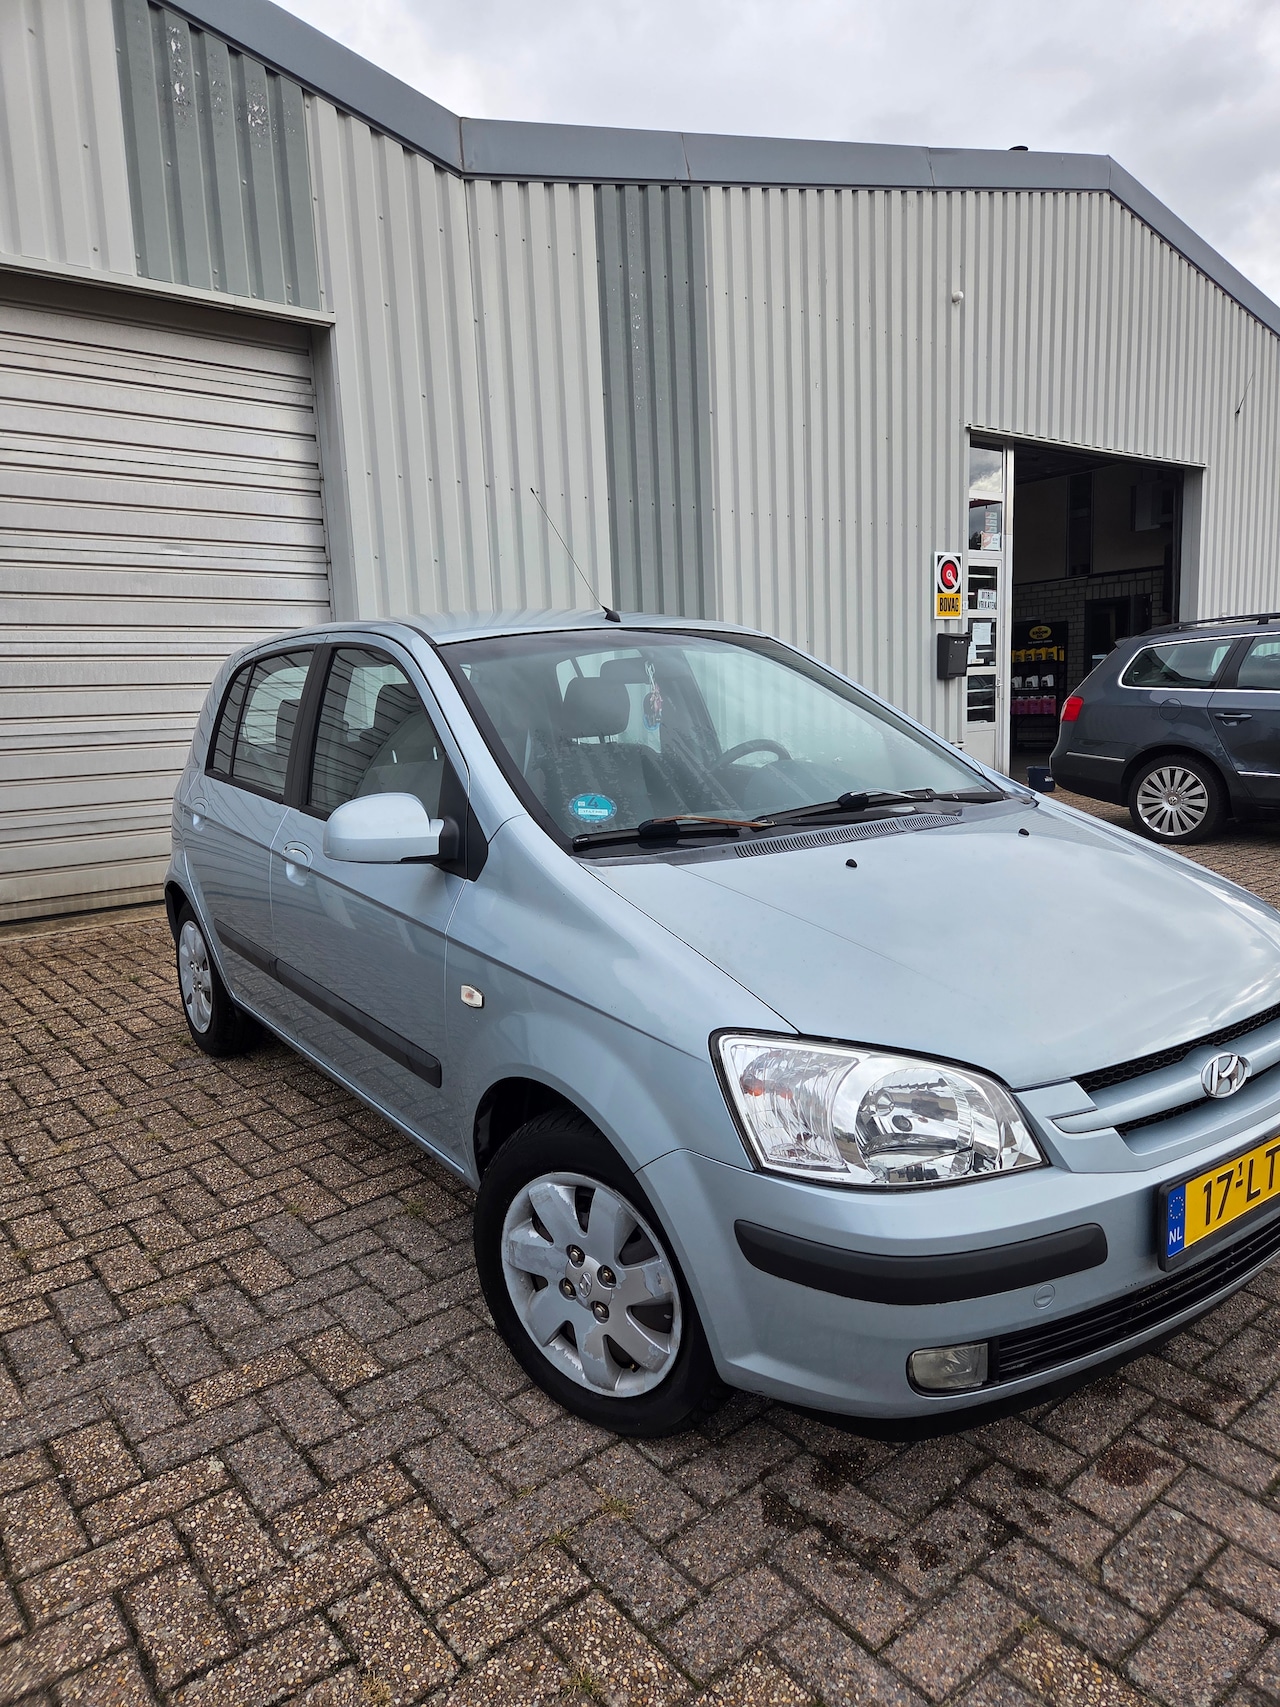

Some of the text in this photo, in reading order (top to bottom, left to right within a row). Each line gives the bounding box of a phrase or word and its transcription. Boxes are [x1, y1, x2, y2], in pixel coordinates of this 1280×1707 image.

[939, 597, 959, 612] BOVAG
[587, 796, 599, 808] 4
[1168, 1226, 1183, 1245] NL
